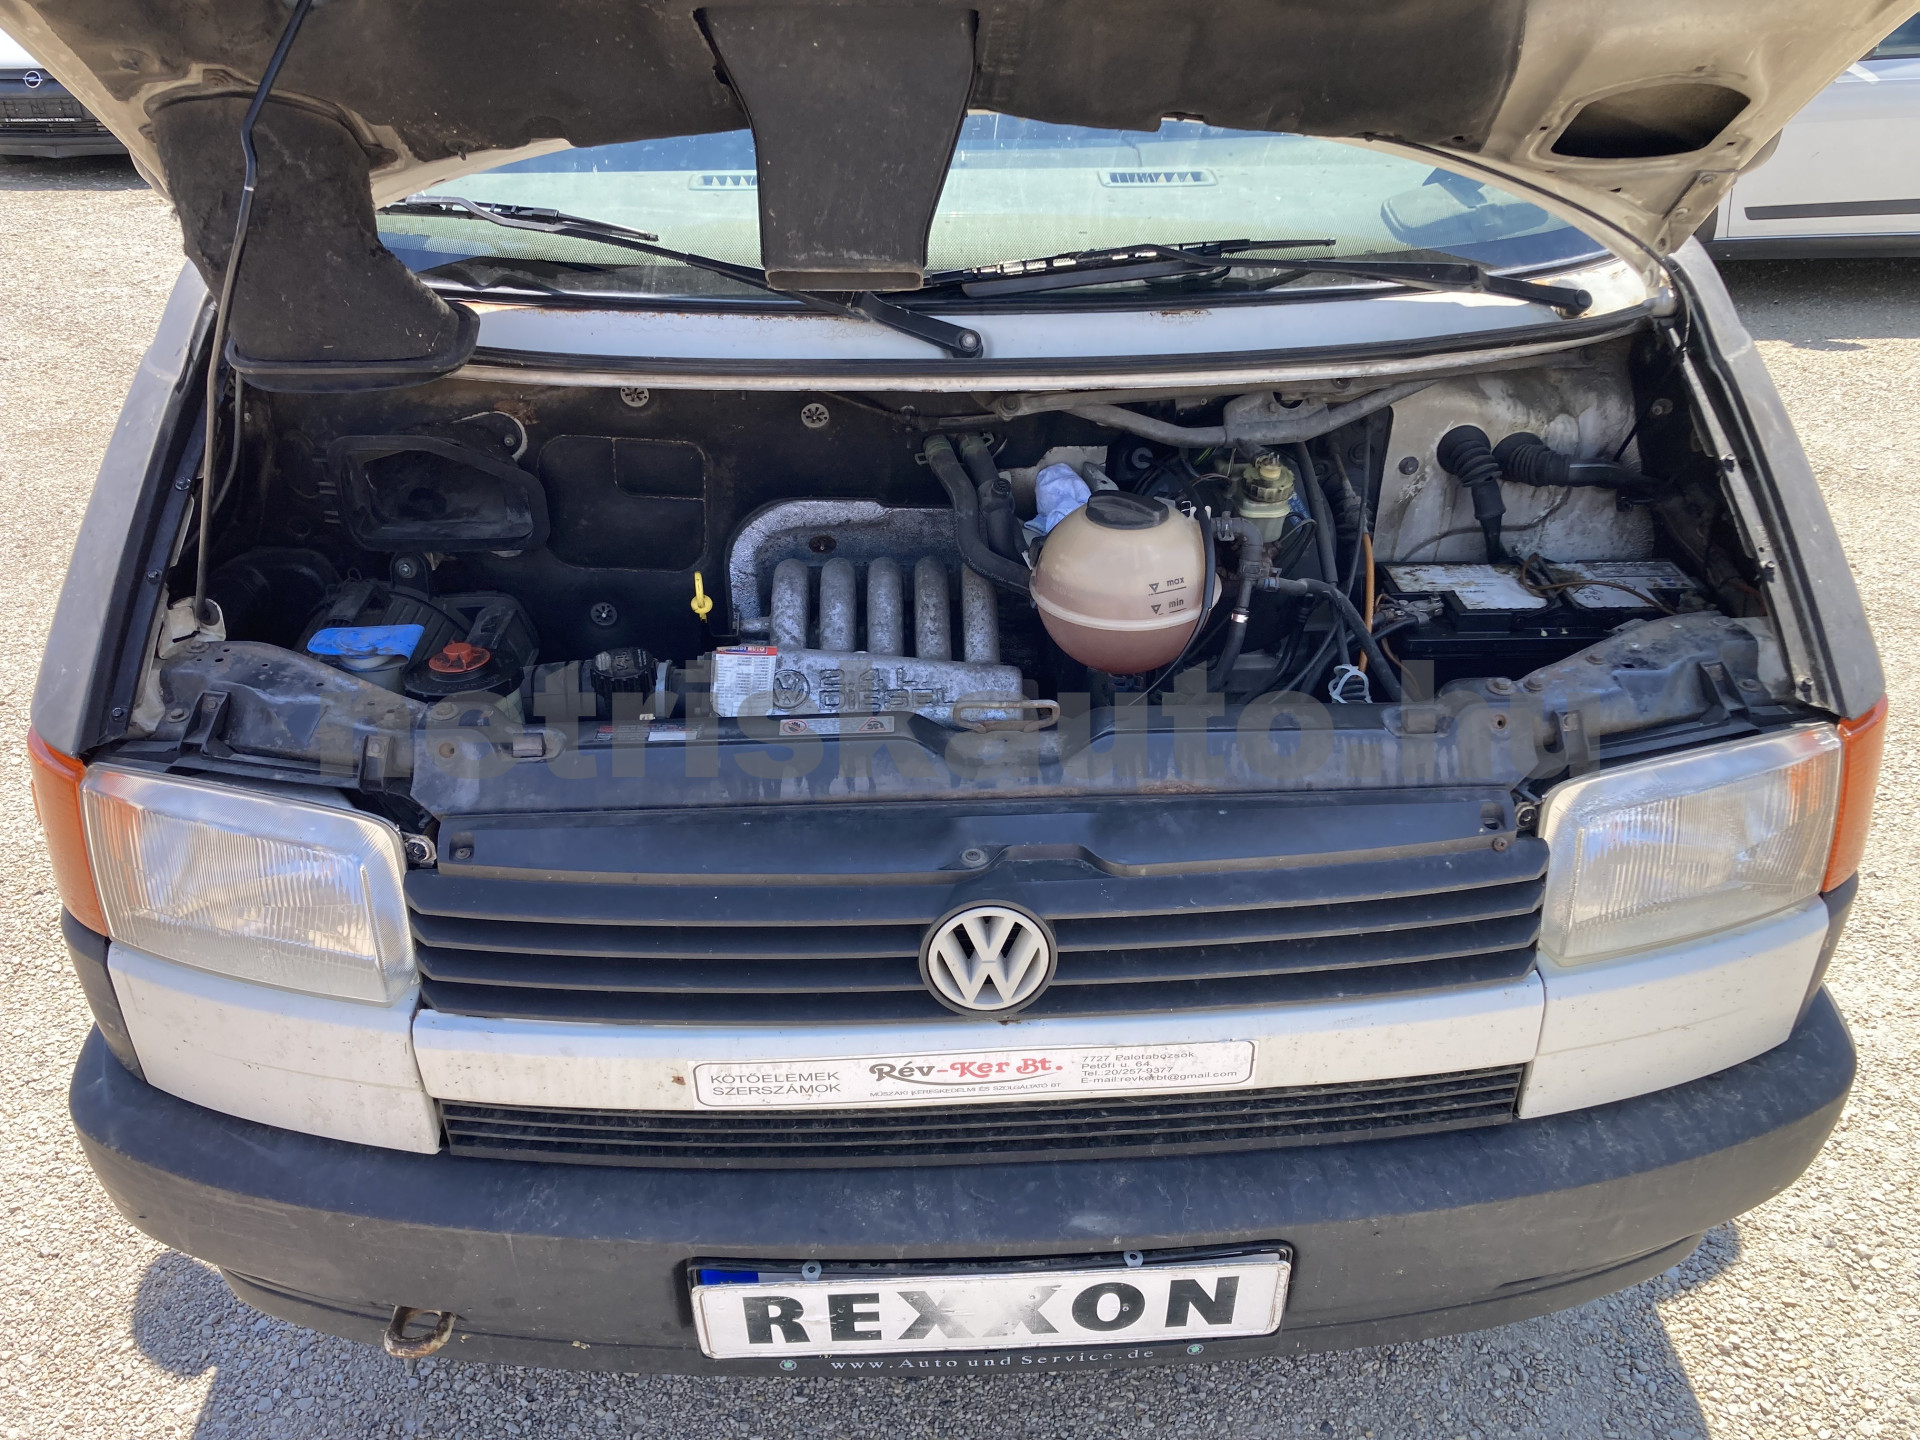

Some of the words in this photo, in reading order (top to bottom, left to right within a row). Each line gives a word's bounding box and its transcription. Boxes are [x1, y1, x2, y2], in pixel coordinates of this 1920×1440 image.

[1166, 577, 1185, 587] max
[1168, 598, 1184, 609] min
[818, 684, 956, 711] DIESEL
[928, 906, 1050, 1011] VW
[1115, 1051, 1195, 1062] Palotabozsok
[868, 1060, 1010, 1082] Rév-Ker
[1016, 1057, 1064, 1075] Bt.
[711, 1071, 840, 1084] KÖTŐELEMEK
[1081, 1070, 1237, 1084] E-mail:revkerbt@gmail.com
[713, 1083, 841, 1096] SZERSZÁMOK
[911, 1086, 977, 1096] KERESKEDELMI
[742, 1276, 1240, 1346] REXXON
[968, 1355, 1012, 1367] und
